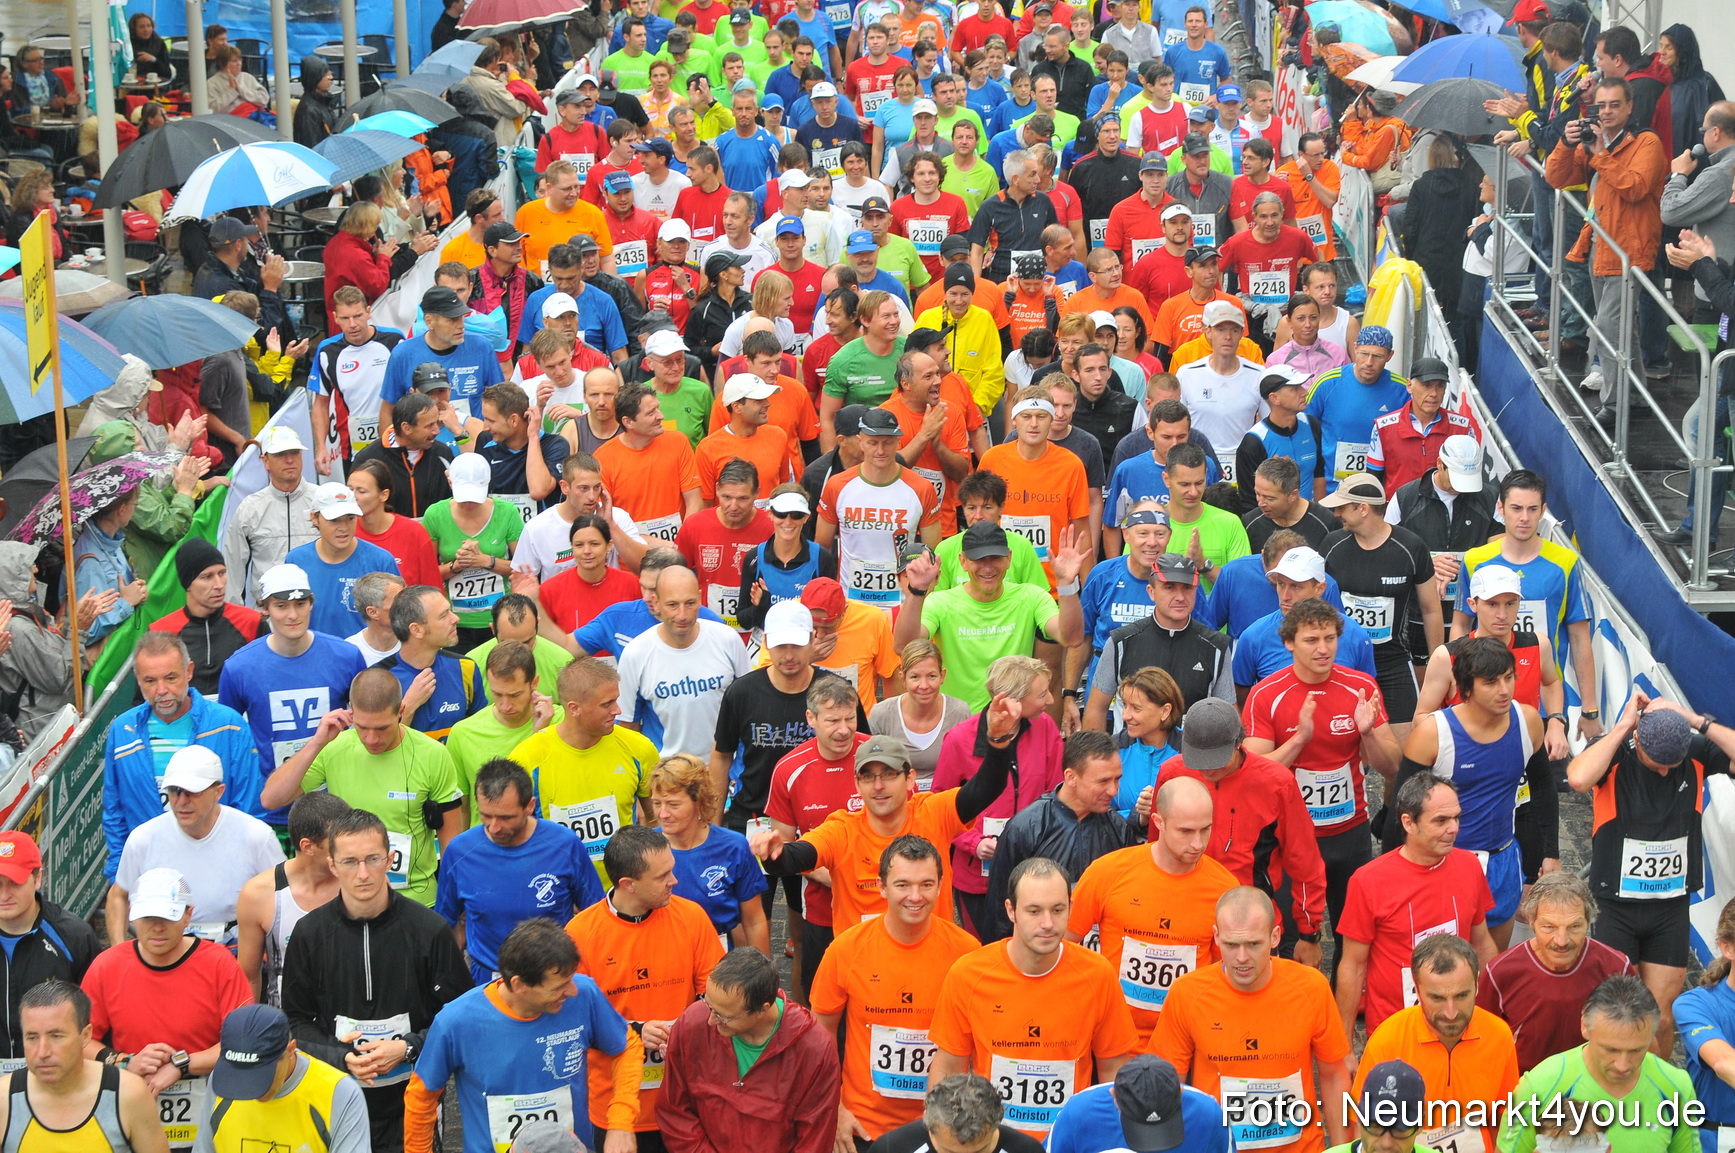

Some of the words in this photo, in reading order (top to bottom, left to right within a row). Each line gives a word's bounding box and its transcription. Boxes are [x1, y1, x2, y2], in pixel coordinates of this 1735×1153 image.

[1185, 91, 1204, 101] 560
[912, 229, 943, 243] 2306
[614, 249, 645, 266] 3435
[1253, 281, 1286, 295] 2248
[1188, 321, 1202, 329] Fis
[1346, 454, 1365, 471] 28
[1031, 493, 1061, 503] POLES
[843, 507, 908, 523] MERZ
[843, 517, 894, 532] Reisen
[454, 576, 497, 598] 2277
[853, 571, 897, 590] 3218
[1381, 576, 1407, 585] THULE
[860, 591, 887, 600] Norbert
[467, 599, 488, 607] Katrin
[1344, 606, 1387, 627] 2331
[654, 674, 725, 700] Gothaer
[1302, 783, 1349, 805] 2121
[1308, 807, 1345, 818] Christian
[556, 813, 614, 840] 606
[55, 825, 78, 872] Mehr
[1629, 855, 1683, 878] 2329
[1638, 880, 1672, 892] Thomas
[1123, 927, 1169, 939] kellermann
[607, 982, 651, 997] kellermann
[651, 977, 686, 989] wohnbau
[865, 1005, 913, 1015] kellermann
[991, 1039, 1041, 1048] kellermann
[1208, 1053, 1260, 1062] kellermann
[890, 1076, 924, 1090] Tobias
[998, 1076, 1066, 1105] 3183
[1008, 1107, 1051, 1121] Christof
[1241, 1126, 1285, 1140] Andreas
